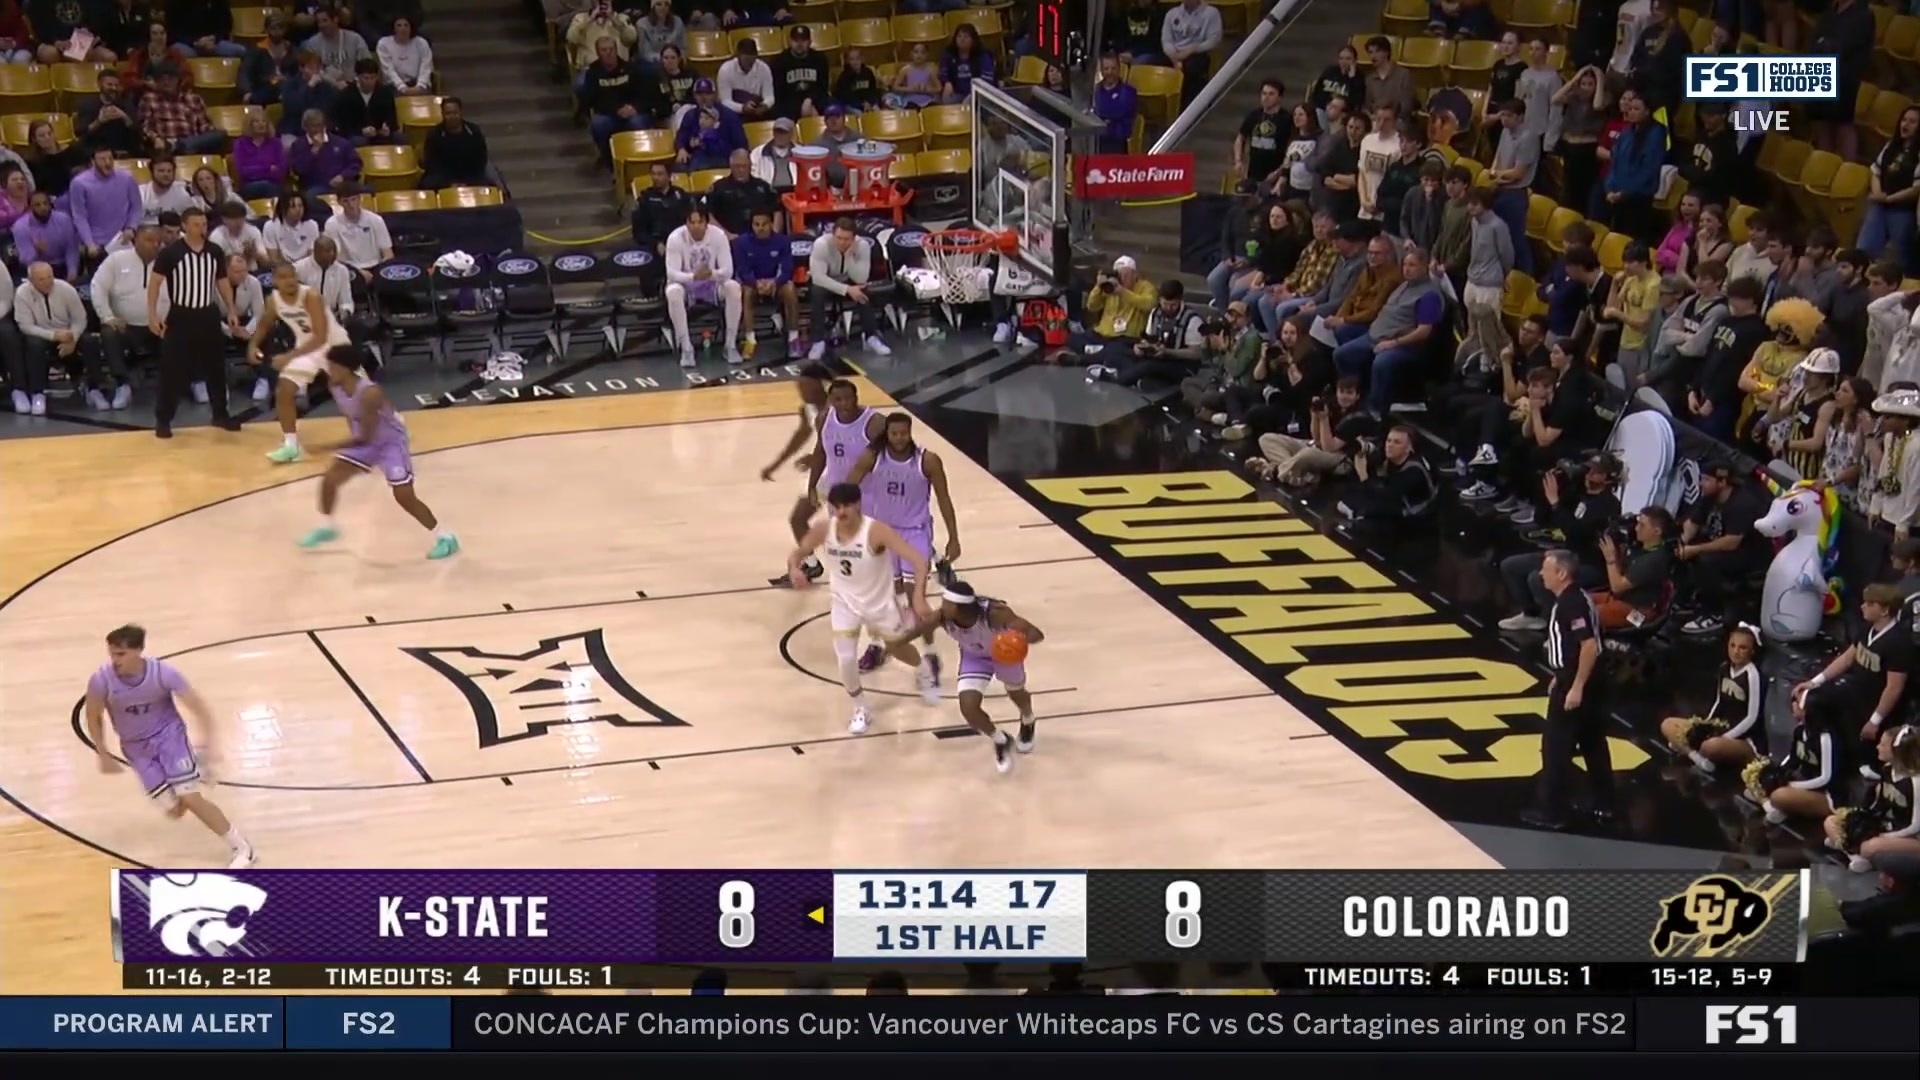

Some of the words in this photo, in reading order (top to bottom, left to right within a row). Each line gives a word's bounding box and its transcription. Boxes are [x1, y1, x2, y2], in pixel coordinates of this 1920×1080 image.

[808, 167, 821, 181] G
[870, 167, 882, 180] G
[1107, 169, 1146, 184] State
[1146, 167, 1185, 182] Farm
[414, 375, 660, 406] ELEVATION
[834, 442, 845, 458] 6
[887, 481, 905, 497] 21
[840, 559, 853, 577] 3
[1026, 470, 1652, 780] BUFFALOES
